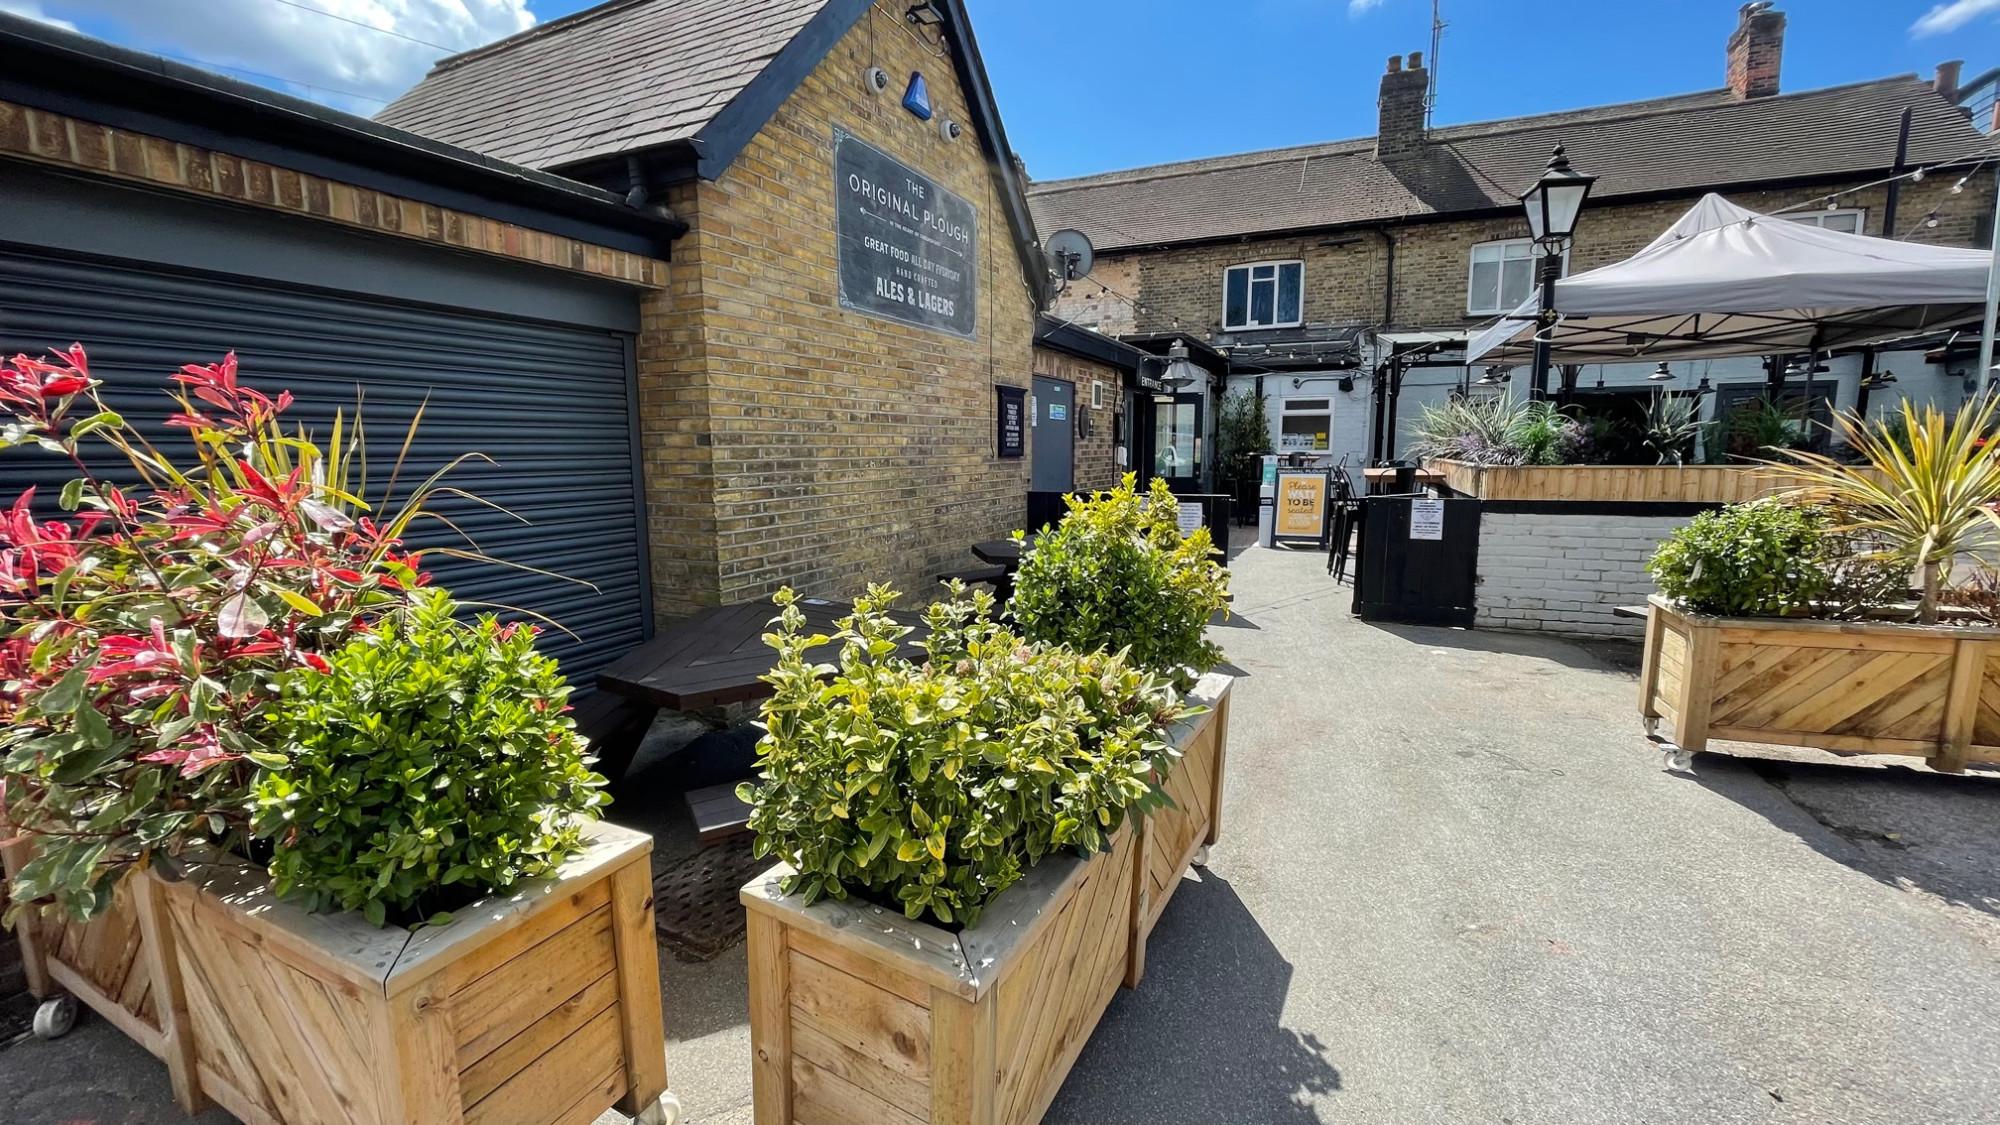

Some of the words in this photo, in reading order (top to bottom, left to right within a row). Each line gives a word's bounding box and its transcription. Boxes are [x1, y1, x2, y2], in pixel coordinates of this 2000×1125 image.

[906, 178, 924, 199] THE
[849, 174, 919, 221] ORIGINAL
[923, 210, 969, 244] PLOUGH
[864, 236, 889, 255] GREAT
[890, 246, 909, 262] FOOD
[911, 254, 922, 268] ALL
[923, 258, 935, 272] DAY
[896, 266, 912, 280] HAND
[913, 272, 938, 288] CRAFTED
[876, 276, 904, 303] ALES
[907, 286, 916, 306] &
[918, 290, 954, 317] LAGERS
[1141, 376, 1162, 391] ENTRANCE
[1288, 481, 1317, 490] Please
